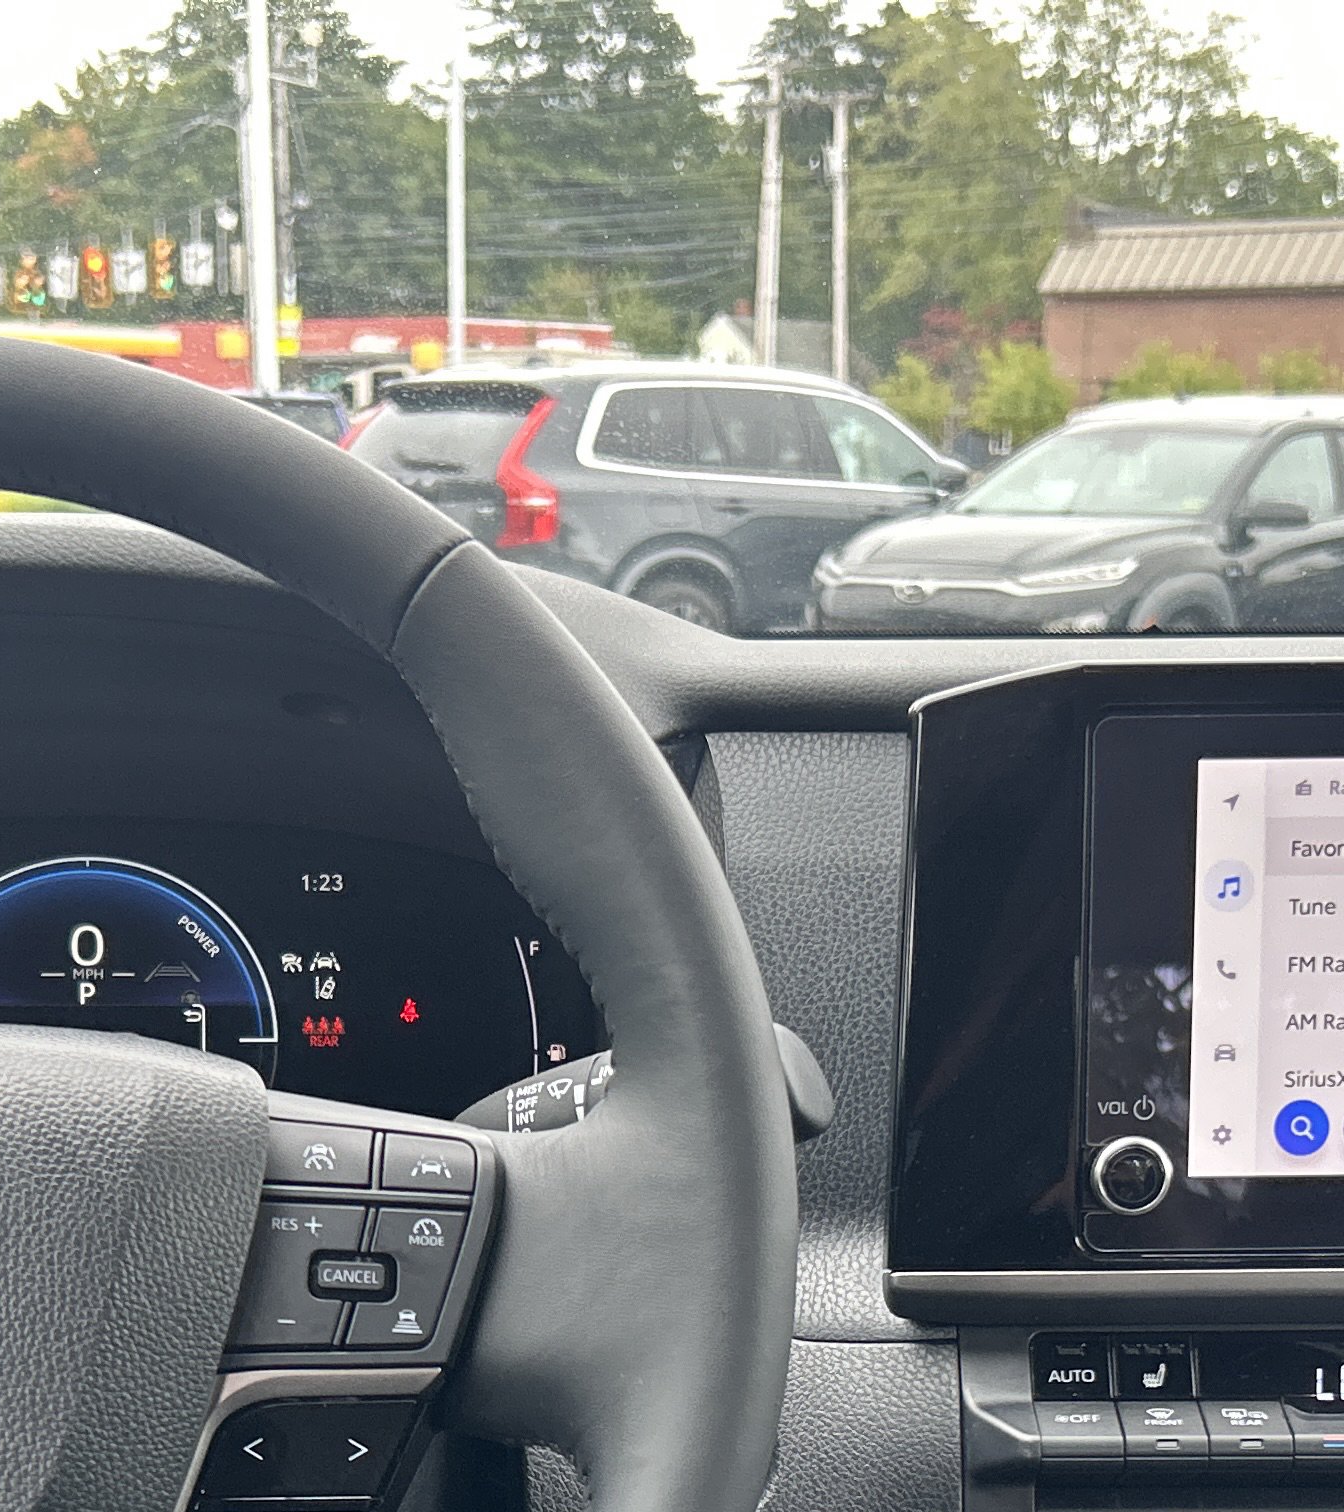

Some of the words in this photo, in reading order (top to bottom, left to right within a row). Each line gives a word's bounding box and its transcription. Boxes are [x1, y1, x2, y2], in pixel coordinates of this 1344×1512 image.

[301, 874, 344, 892] 1:23
[1289, 898, 1337, 915] Tune
[177, 915, 220, 958] POWER
[70, 925, 104, 967] 0
[529, 941, 540, 957] F
[1288, 957, 1316, 973] FM
[72, 968, 104, 981] MPH
[79, 983, 96, 1006] P
[1285, 1014, 1317, 1031] AM
[309, 1036, 339, 1047] REAR
[516, 1082, 545, 1098] MIST
[515, 1096, 538, 1111] OFF
[1097, 1101, 1129, 1115] VOL
[516, 1110, 536, 1126] INT
[271, 1217, 298, 1232] RES
[408, 1234, 445, 1247] MODE
[323, 1268, 379, 1285] CANCEL
[1048, 1369, 1096, 1384] AUTO
[1069, 1414, 1101, 1424] OFF
[1144, 1418, 1183, 1426] FRONT
[1230, 1418, 1264, 1426] REAR
